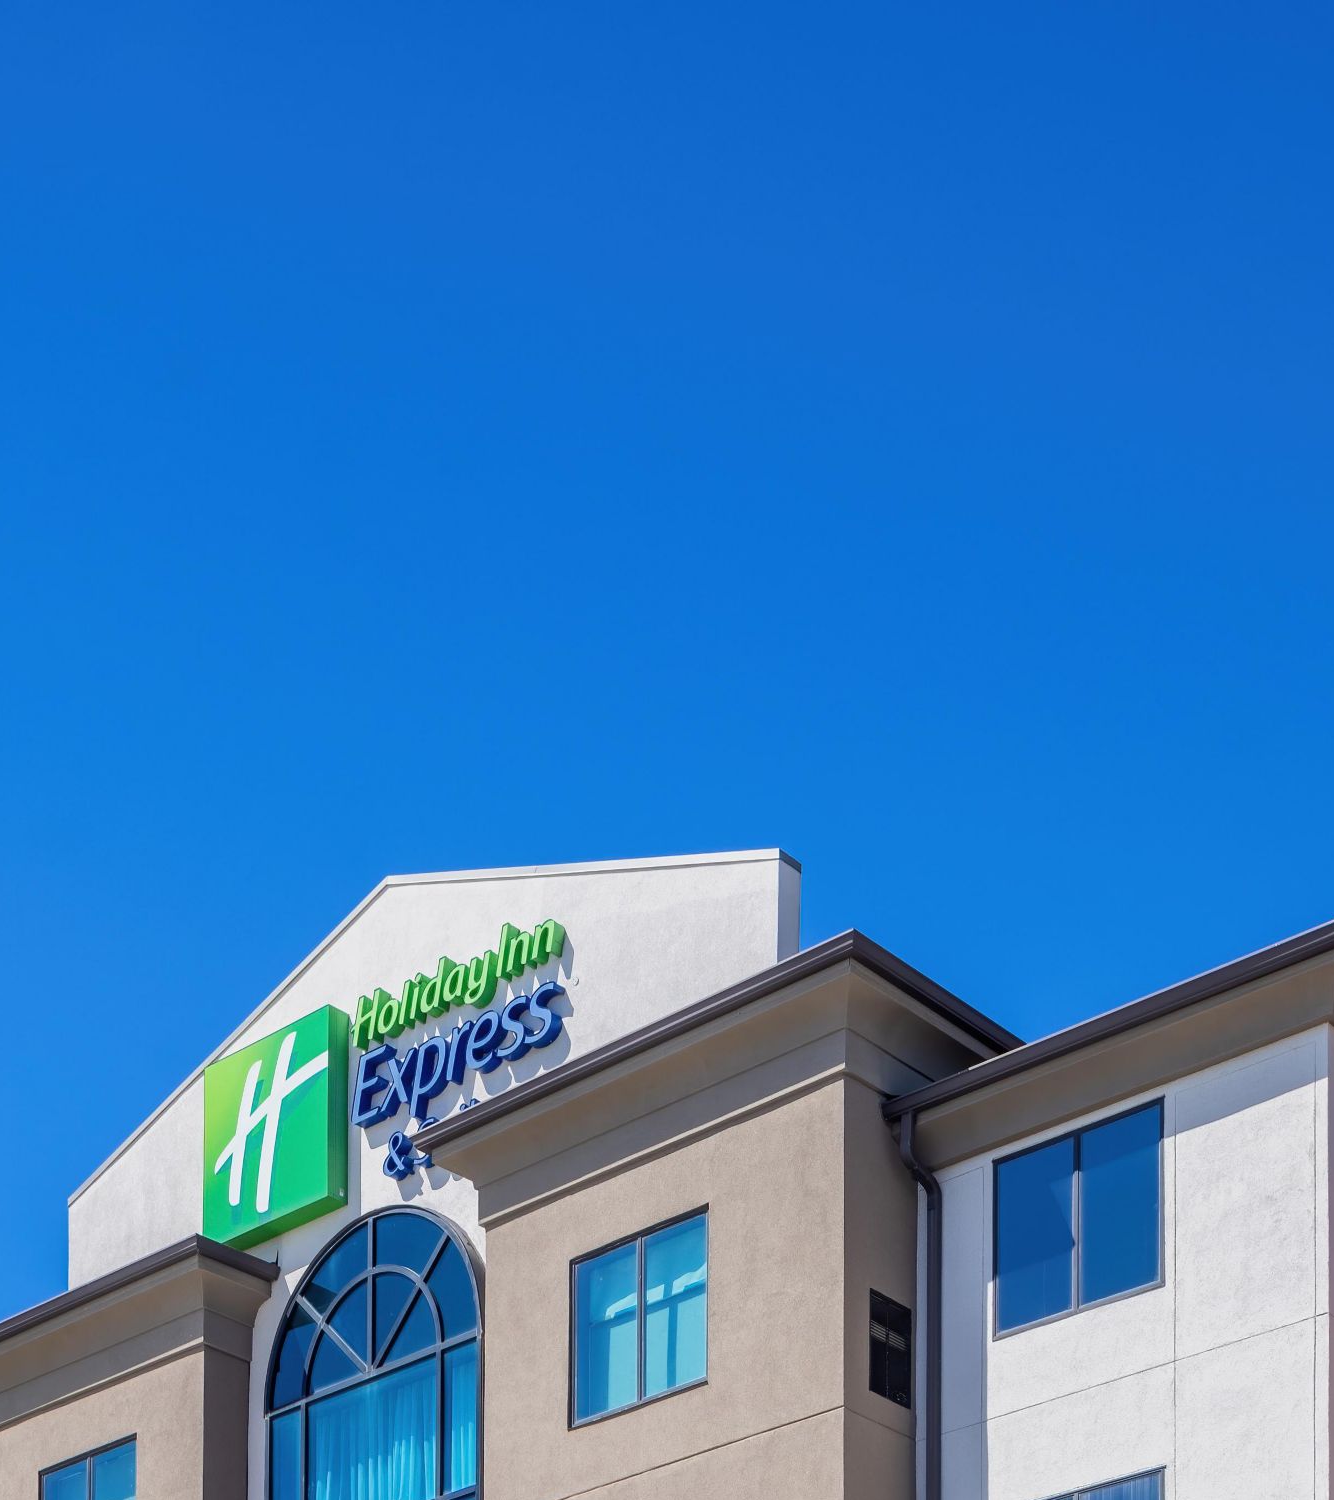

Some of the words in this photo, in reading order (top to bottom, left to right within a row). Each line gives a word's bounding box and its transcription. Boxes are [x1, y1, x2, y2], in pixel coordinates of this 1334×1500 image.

[351, 954, 499, 1050] Holiday
[496, 919, 566, 979] Inn
[351, 981, 566, 1128] Express
[383, 1131, 414, 1181] &
